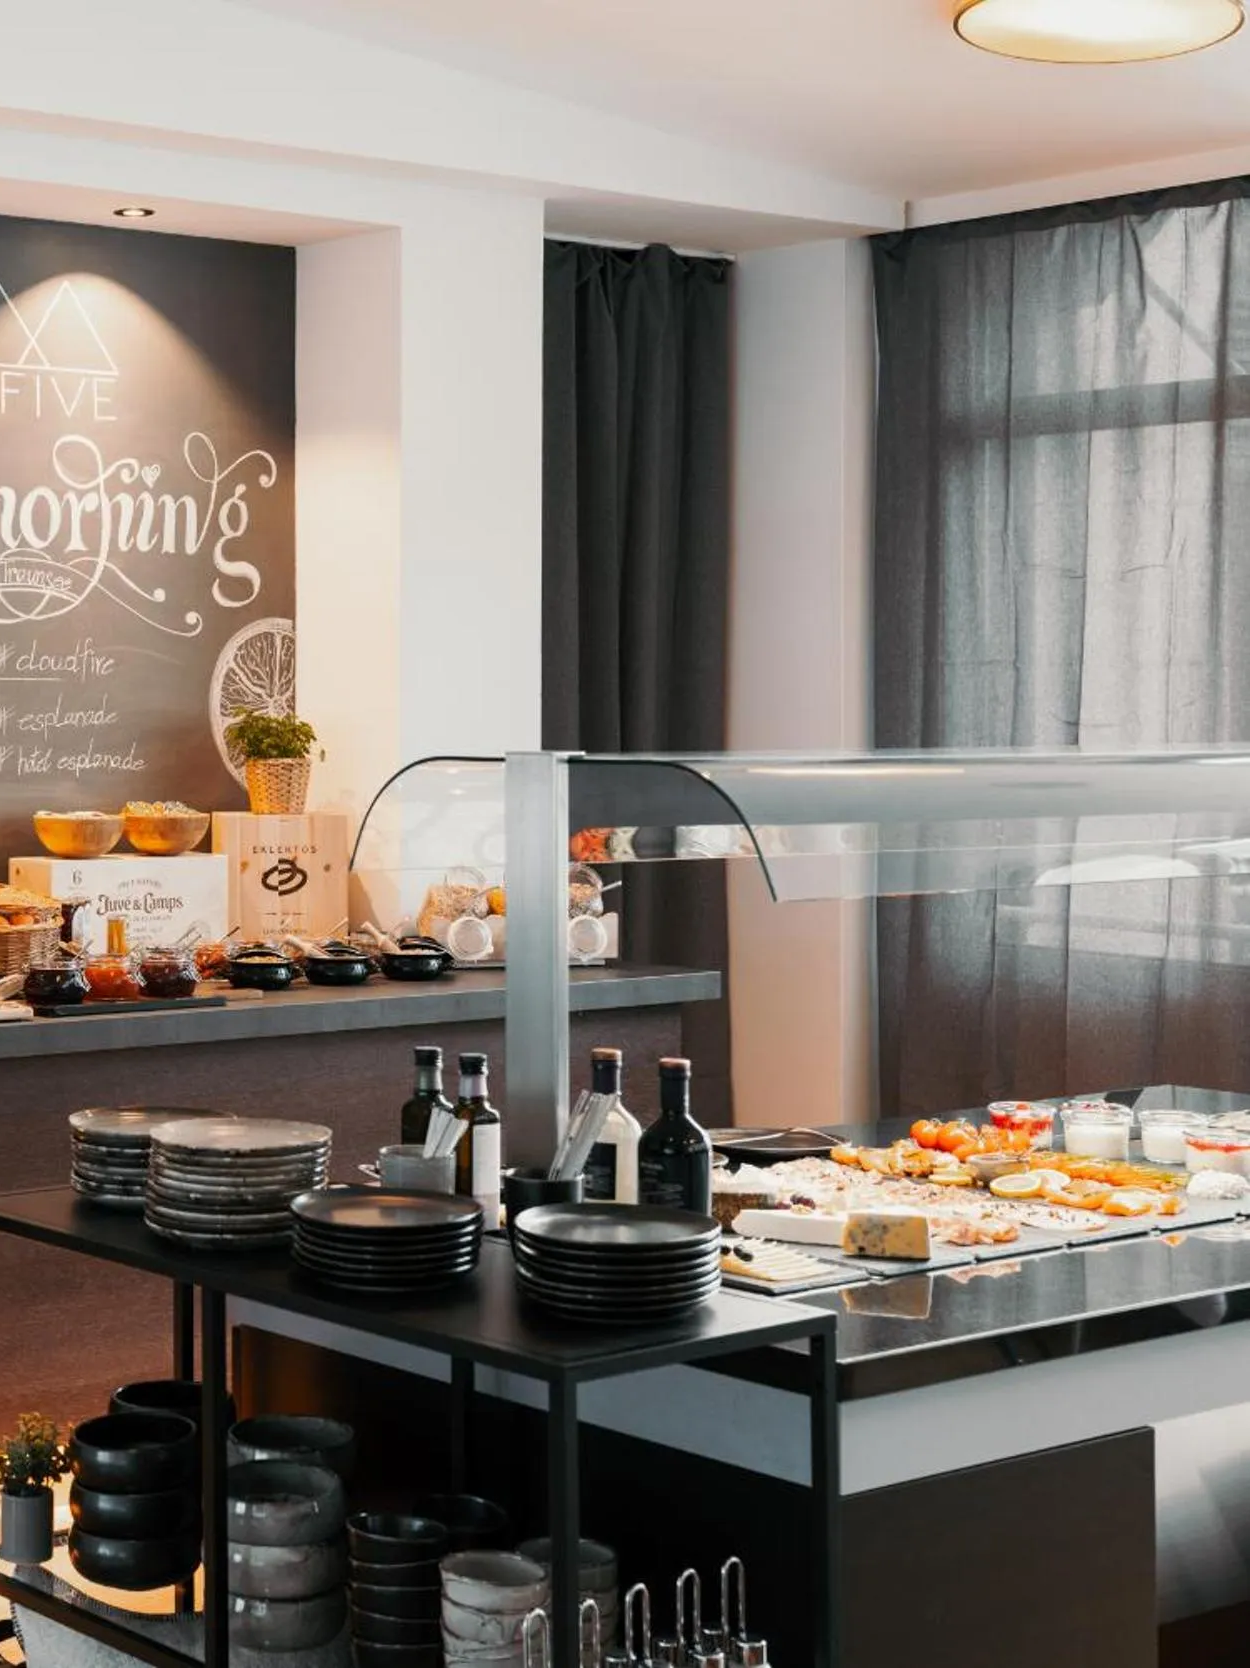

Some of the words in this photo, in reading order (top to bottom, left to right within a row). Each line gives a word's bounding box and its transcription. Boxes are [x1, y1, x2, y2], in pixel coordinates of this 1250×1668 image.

[0, 370, 119, 421] FIVE
[56, 738, 149, 778] esplanade
[71, 868, 83, 886] 6
[132, 901, 142, 911] &
[143, 891, 185, 915] Camps
